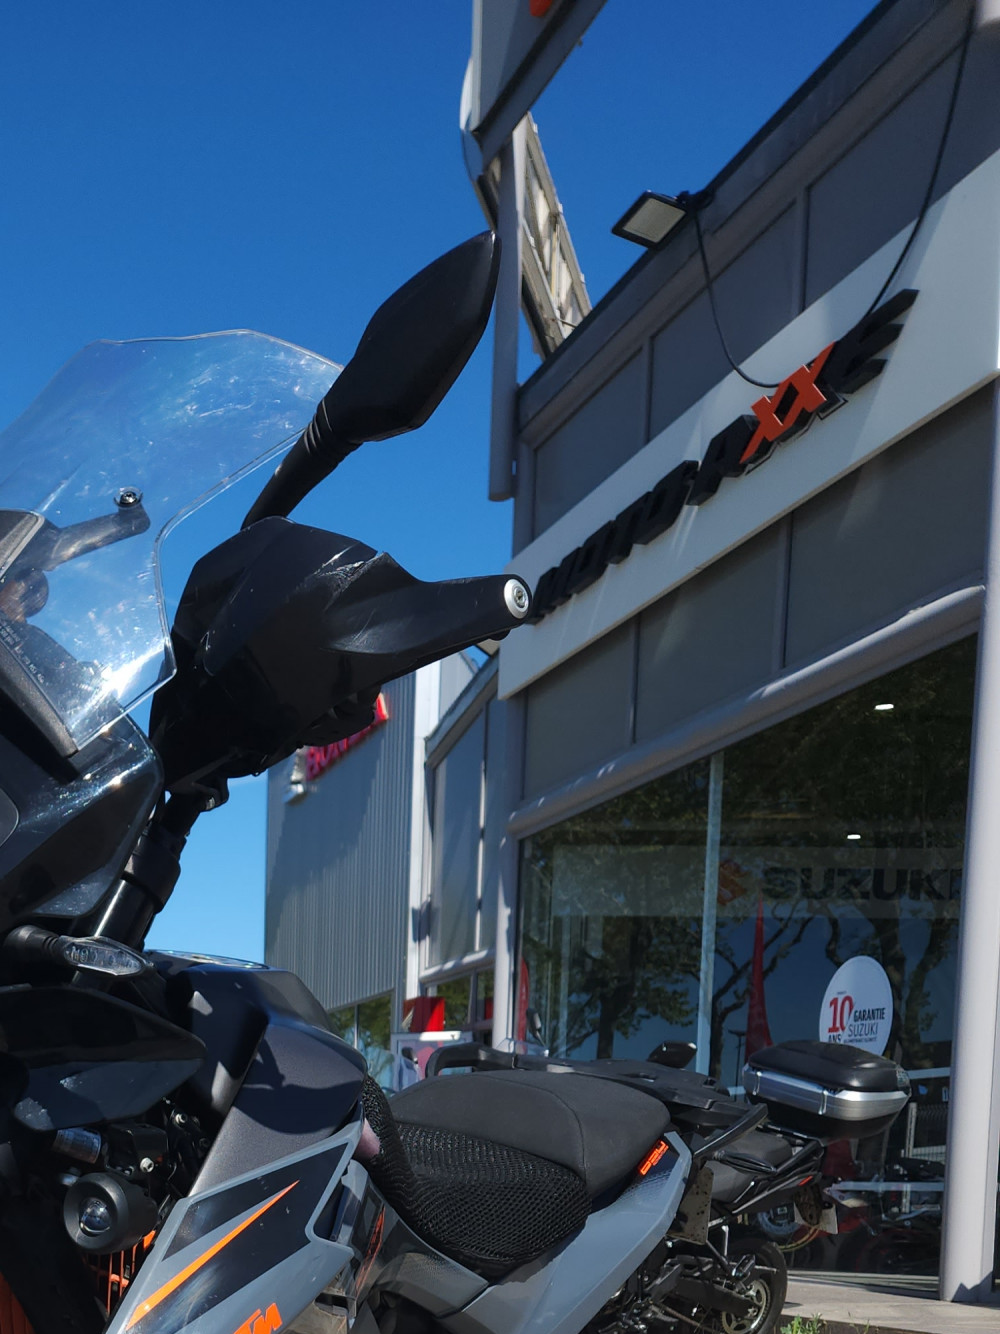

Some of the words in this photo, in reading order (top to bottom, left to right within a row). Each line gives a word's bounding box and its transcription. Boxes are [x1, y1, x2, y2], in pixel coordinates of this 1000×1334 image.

[763, 867, 963, 900] SUZUKI
[828, 995, 854, 1034] 10
[853, 1007, 886, 1022] GARANTIE
[847, 1022, 879, 1037] SUZUKI
